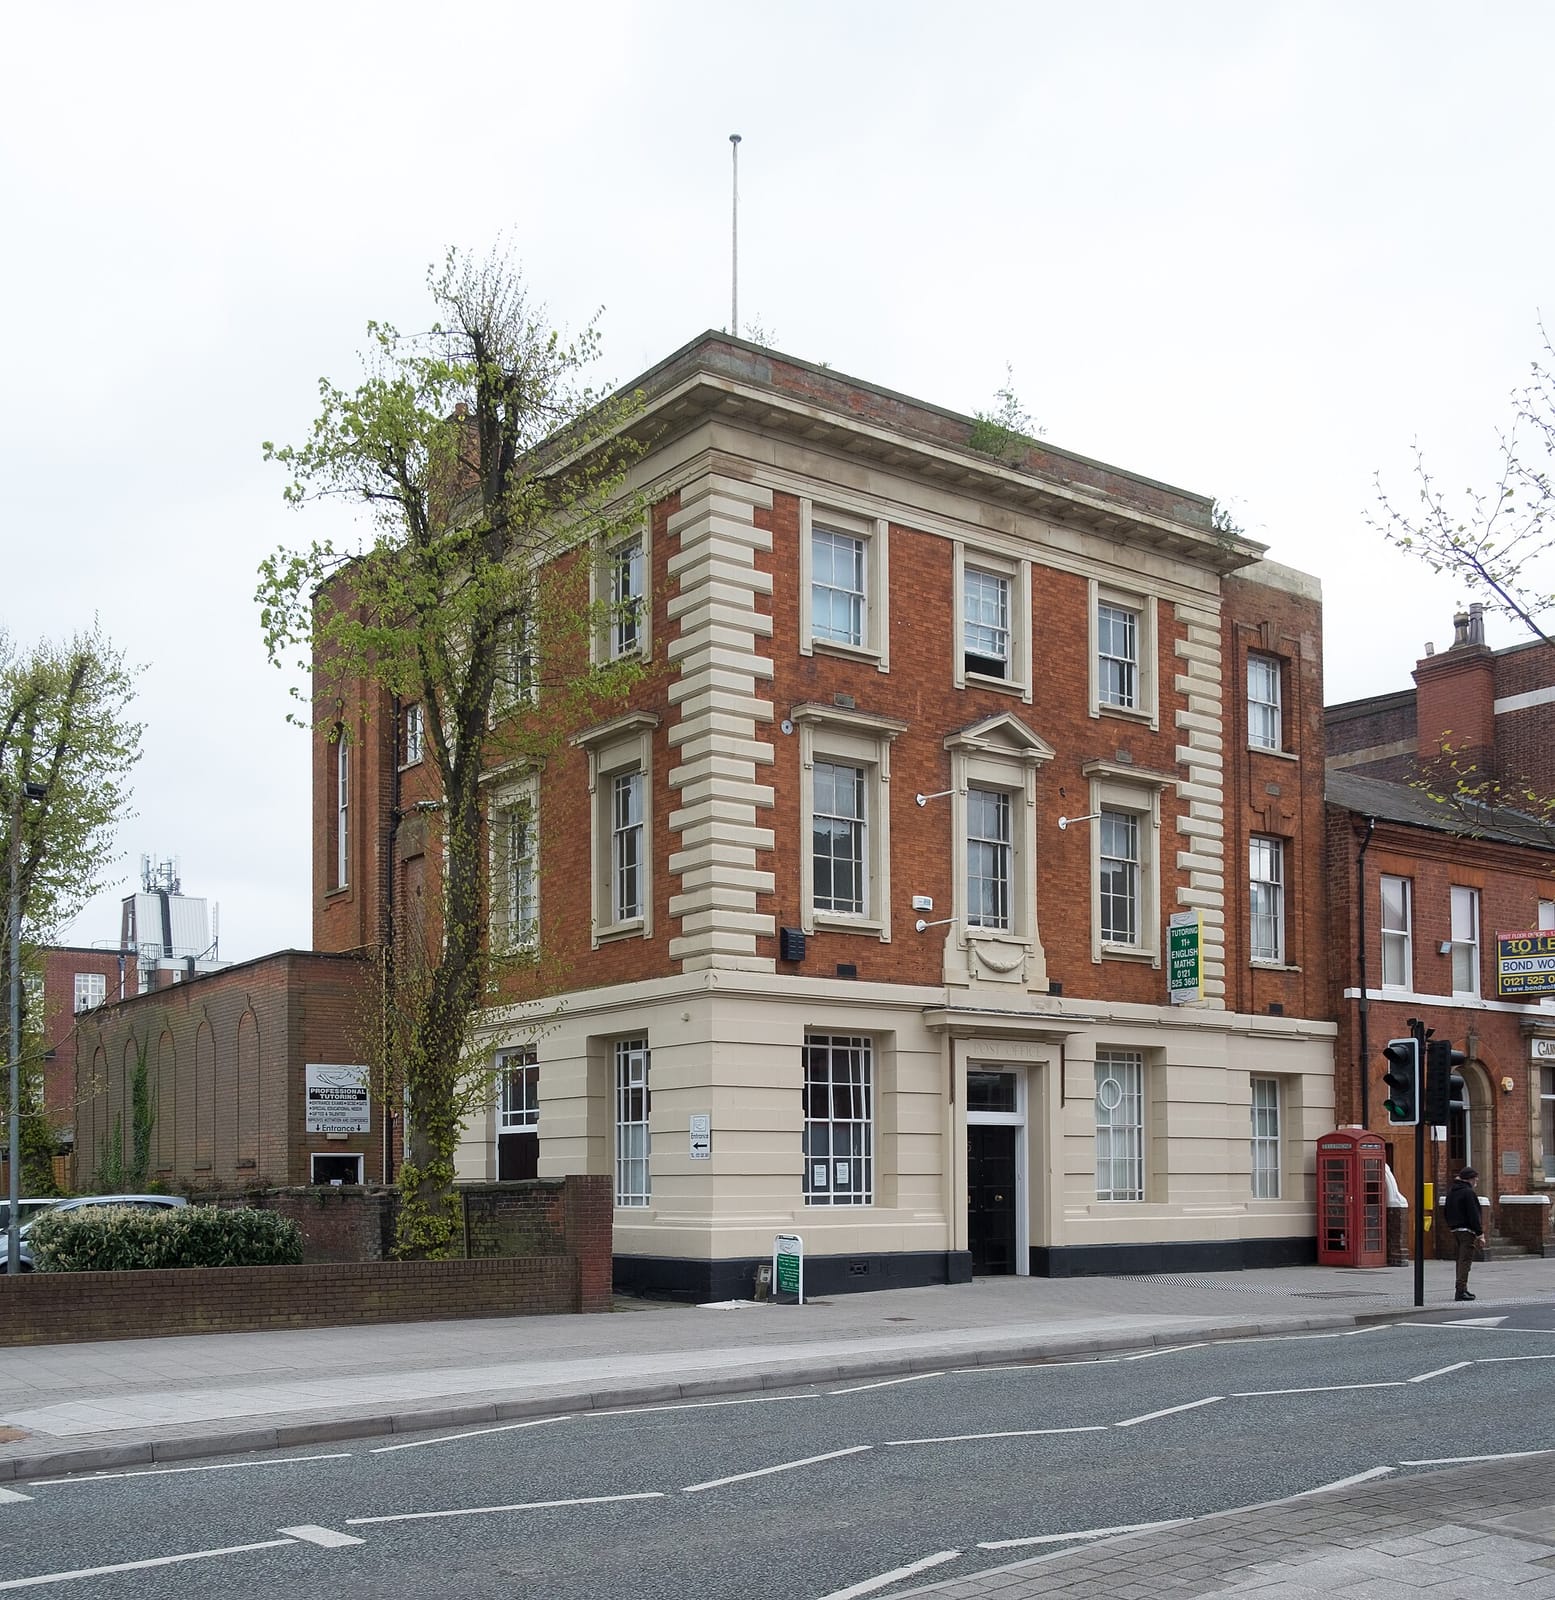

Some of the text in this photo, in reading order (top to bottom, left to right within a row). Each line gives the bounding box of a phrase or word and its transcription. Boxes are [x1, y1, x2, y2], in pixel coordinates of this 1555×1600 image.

[1171, 927, 1198, 936] TUTORING
[1181, 938, 1190, 946] 11+
[1508, 939, 1532, 953] TO
[1171, 948, 1198, 959] ENGLISH
[1174, 958, 1195, 969] MATHS
[1503, 961, 1533, 971] BOND
[1177, 969, 1190, 978] 0121
[1503, 976, 1524, 987] 0121
[1527, 975, 1545, 985] 525
[974, 1041, 1042, 1058] POST OFFICE
